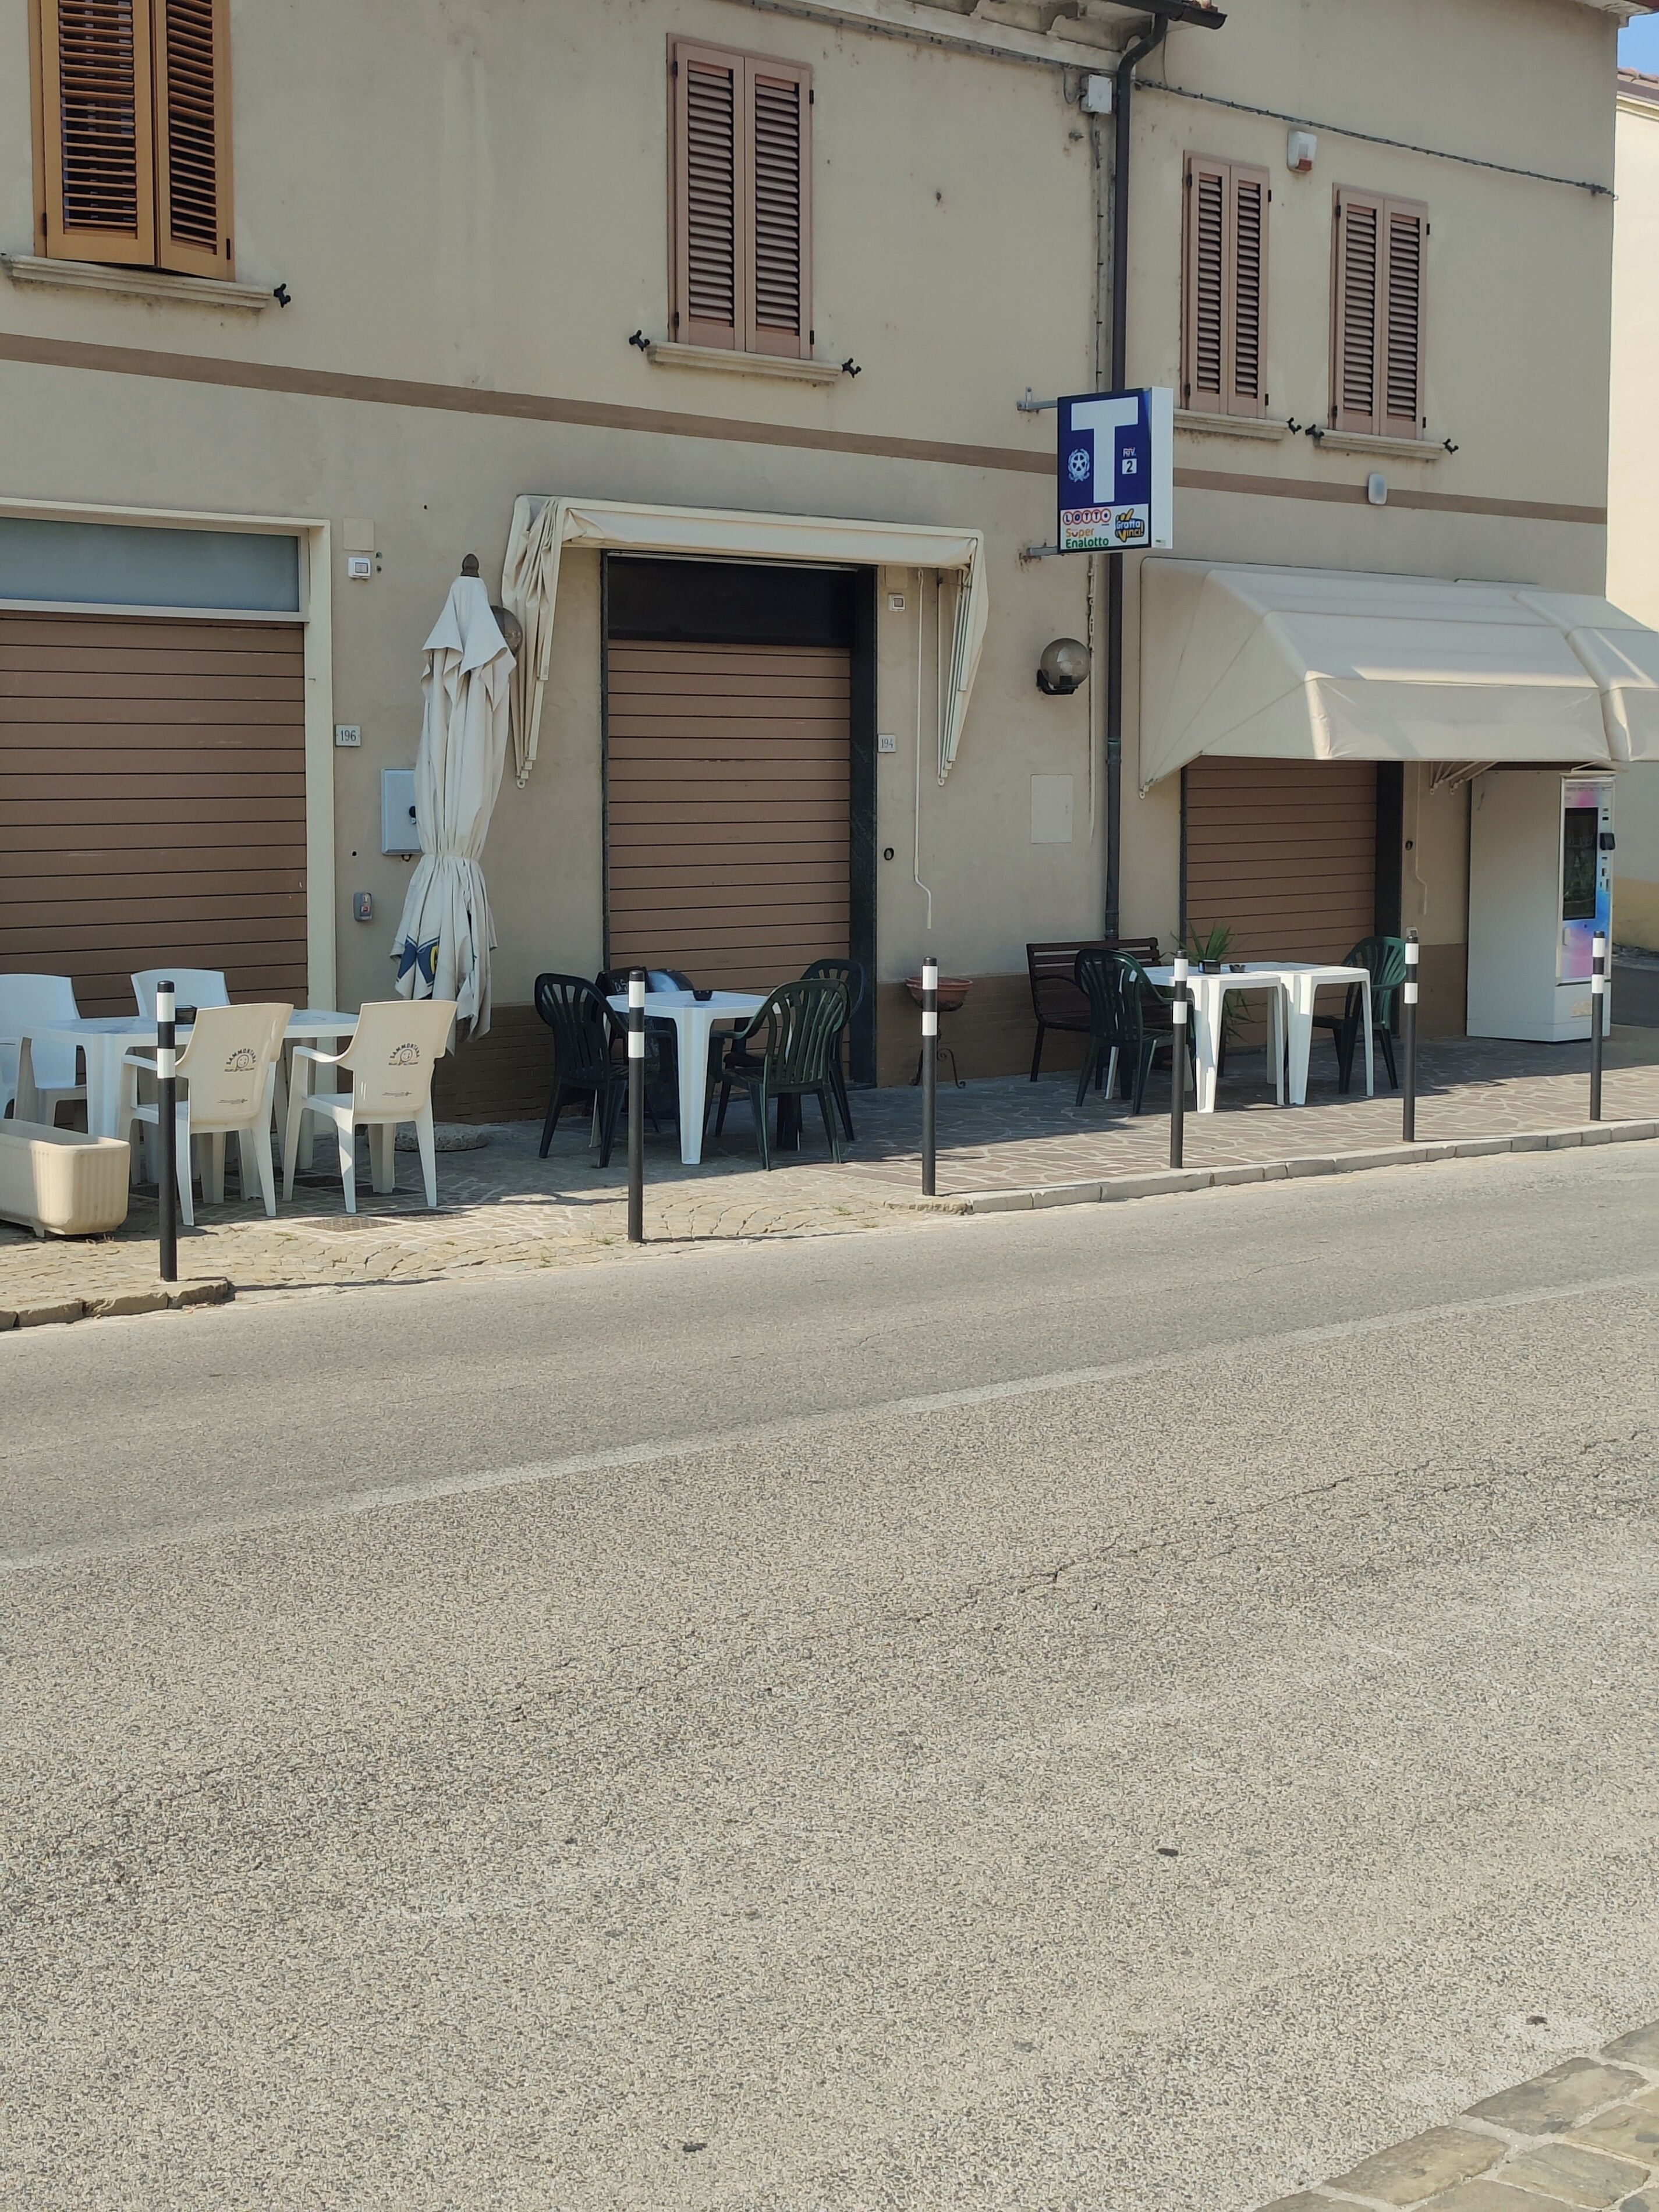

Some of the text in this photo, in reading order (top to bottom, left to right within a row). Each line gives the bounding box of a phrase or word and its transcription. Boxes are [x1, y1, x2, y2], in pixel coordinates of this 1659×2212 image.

[1071, 396, 1139, 504] T
[1126, 460, 1133, 473] 2
[1064, 510, 1109, 524] LOTTO
[1116, 519, 1140, 529] Gratta
[1066, 528, 1094, 538] Super
[1066, 537, 1109, 548] Enalotto
[341, 730, 356, 741] 196
[881, 738, 894, 749] 194
